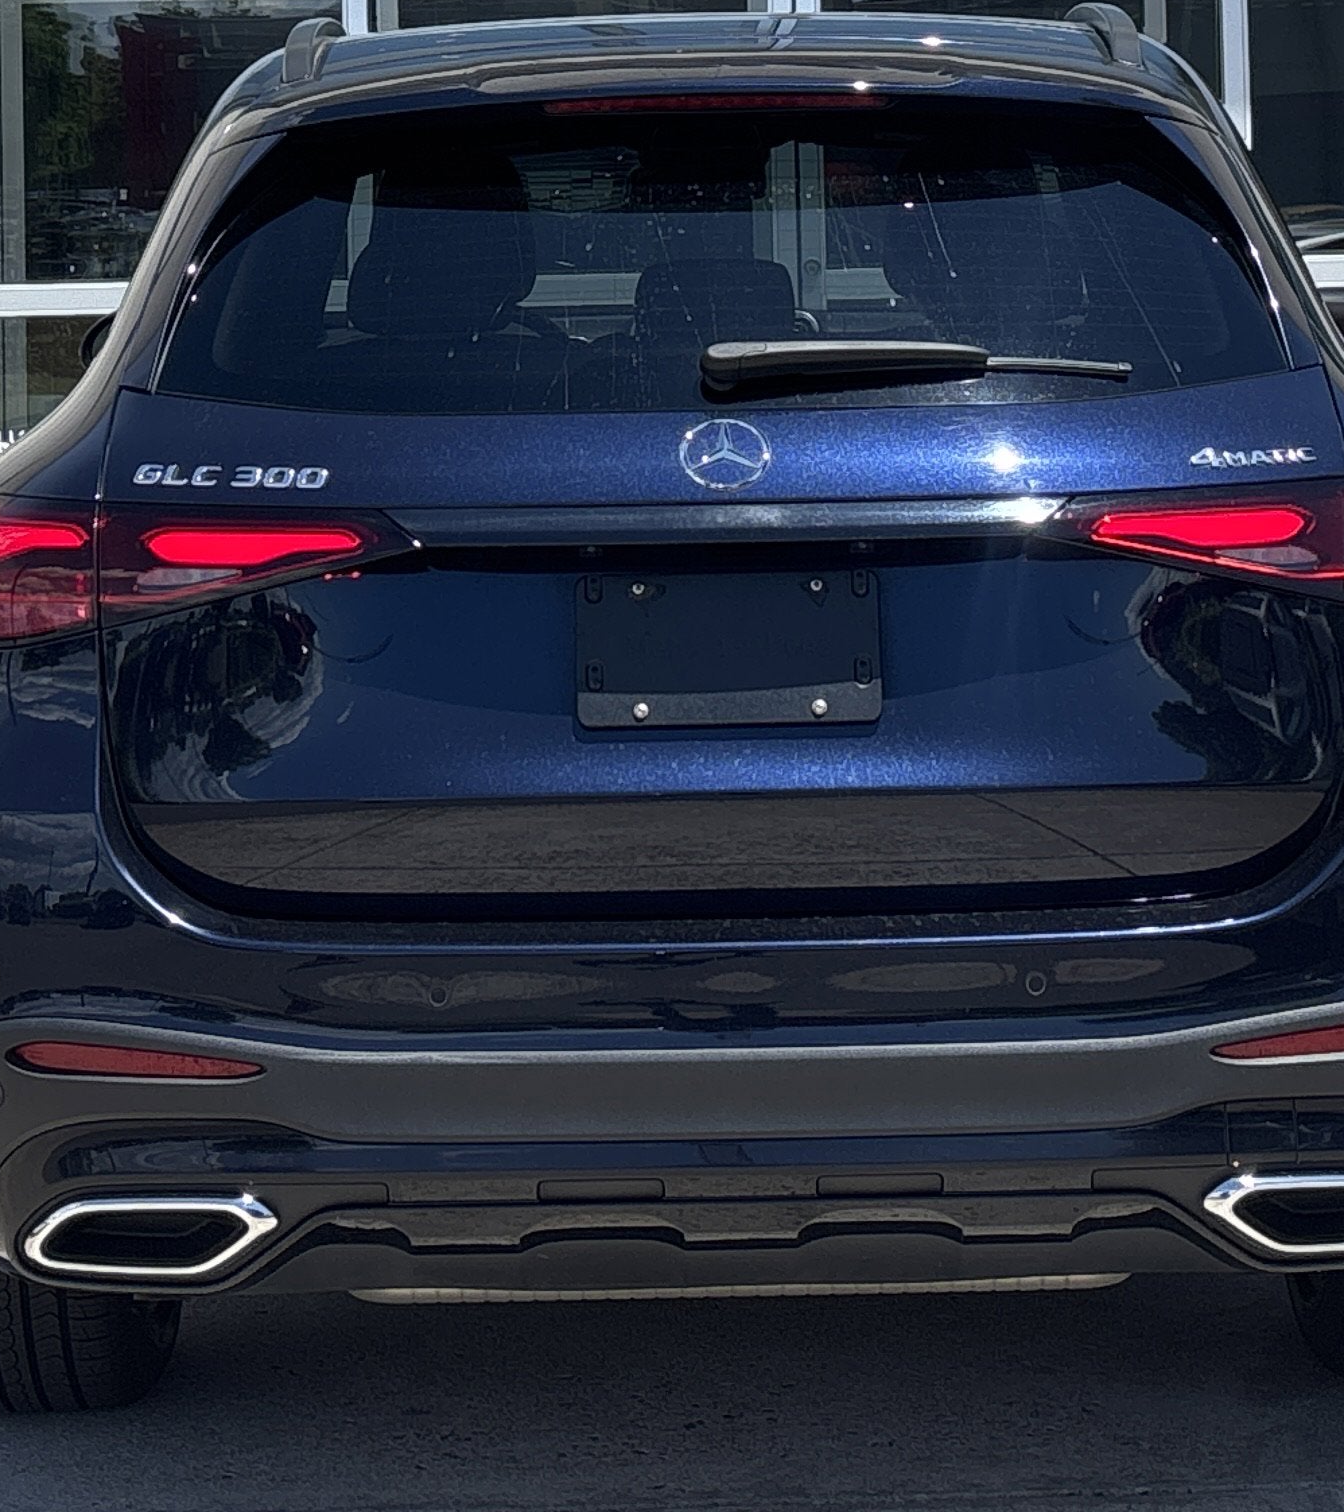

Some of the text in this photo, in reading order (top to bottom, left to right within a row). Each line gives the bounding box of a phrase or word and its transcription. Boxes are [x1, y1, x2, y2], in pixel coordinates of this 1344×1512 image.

[1189, 447, 1317, 468] 4MATIC
[132, 463, 329, 489] GLC 300
